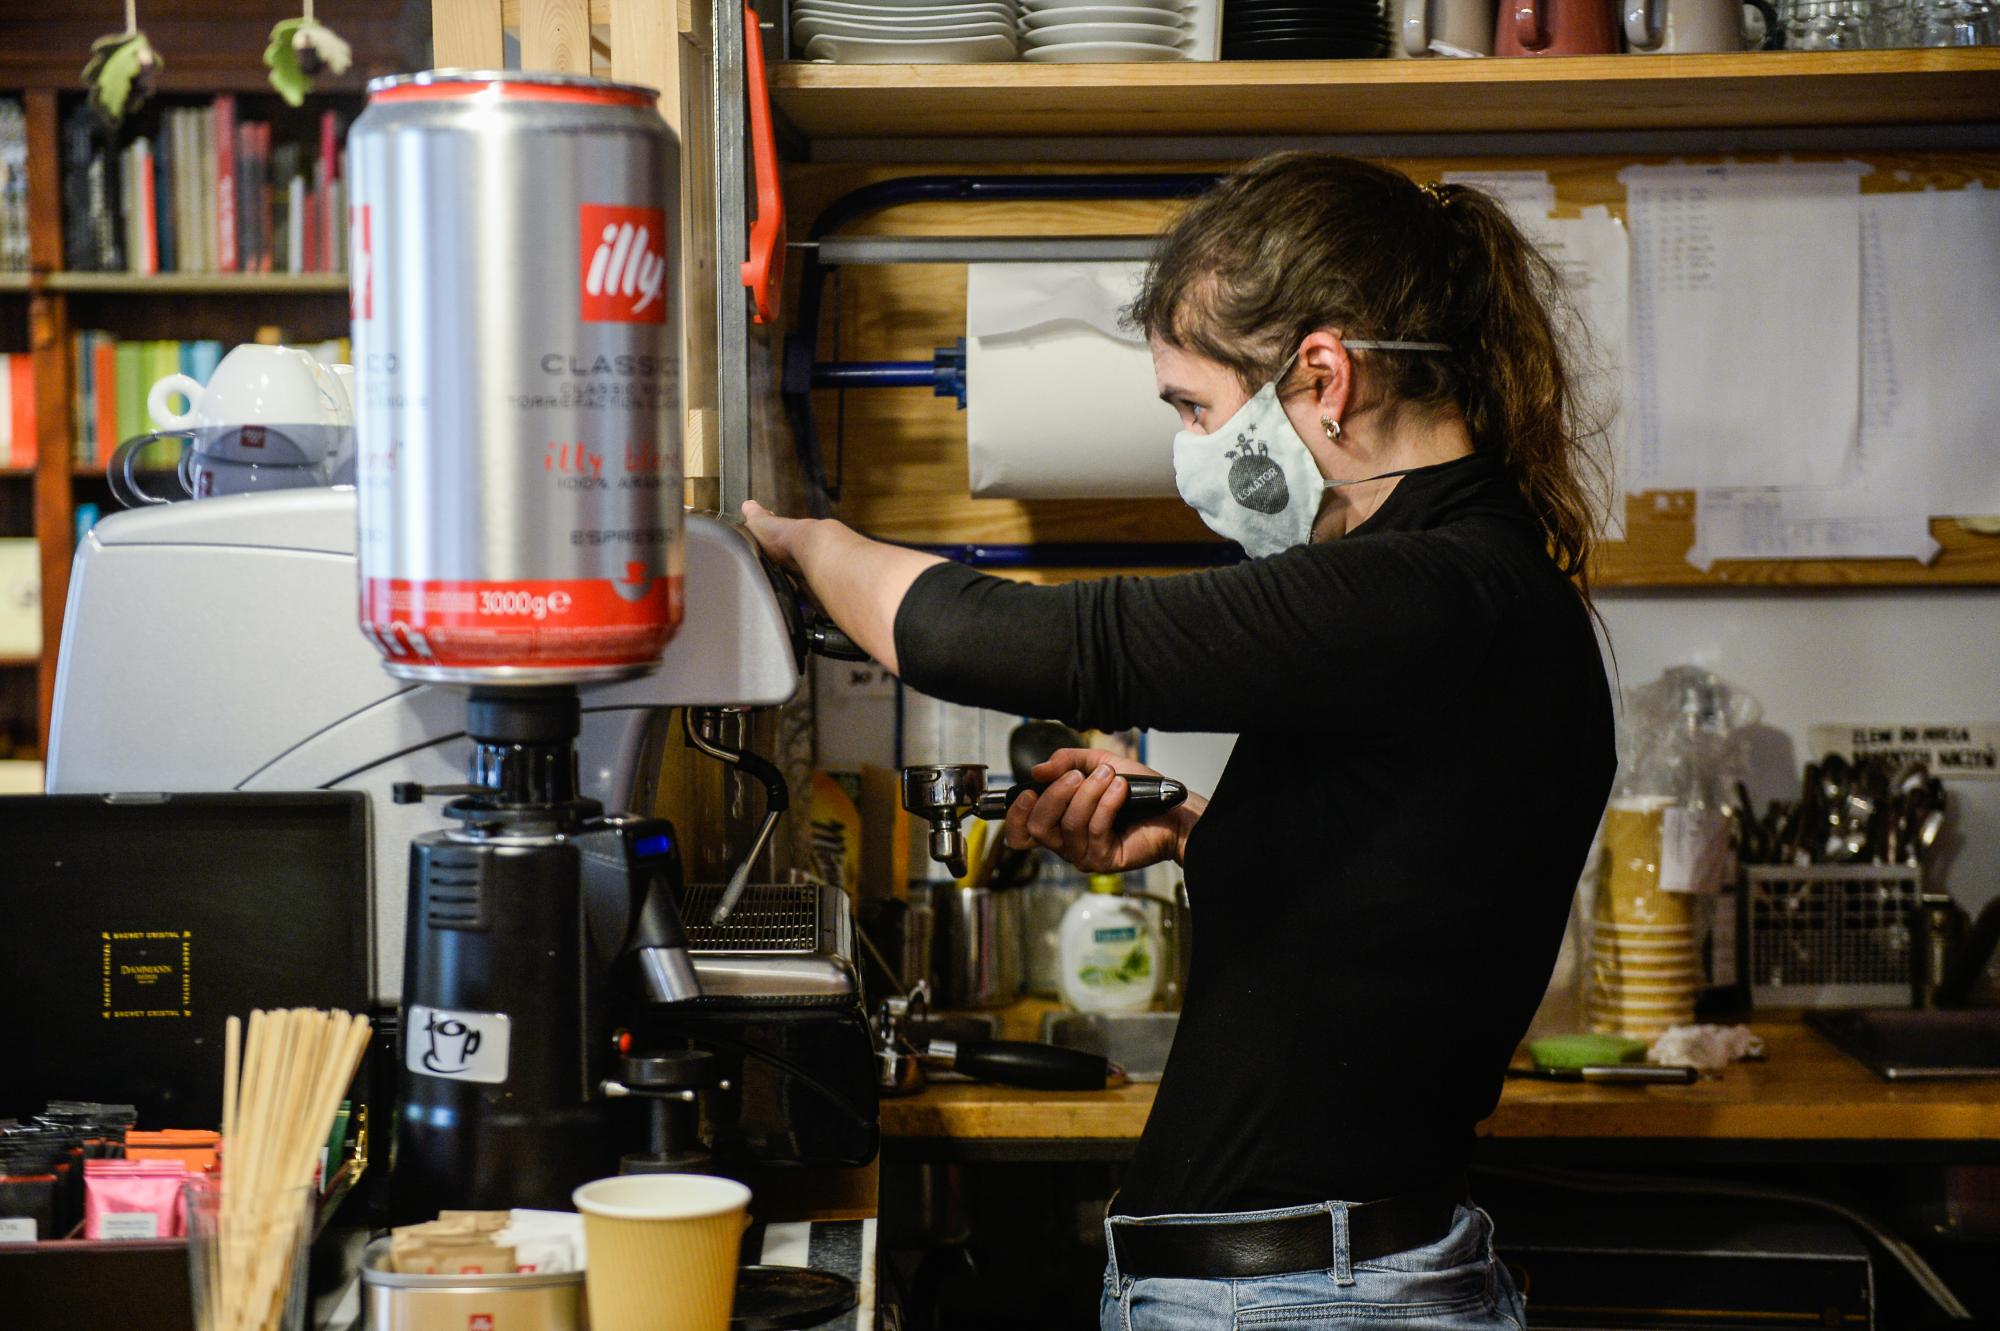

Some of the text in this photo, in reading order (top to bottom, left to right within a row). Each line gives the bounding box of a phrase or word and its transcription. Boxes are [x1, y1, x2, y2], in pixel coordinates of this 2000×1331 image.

[586, 222, 665, 315] illy
[544, 439, 604, 479] illy
[1237, 467, 1279, 501] LOKATOR
[479, 590, 548, 620] 3000g
